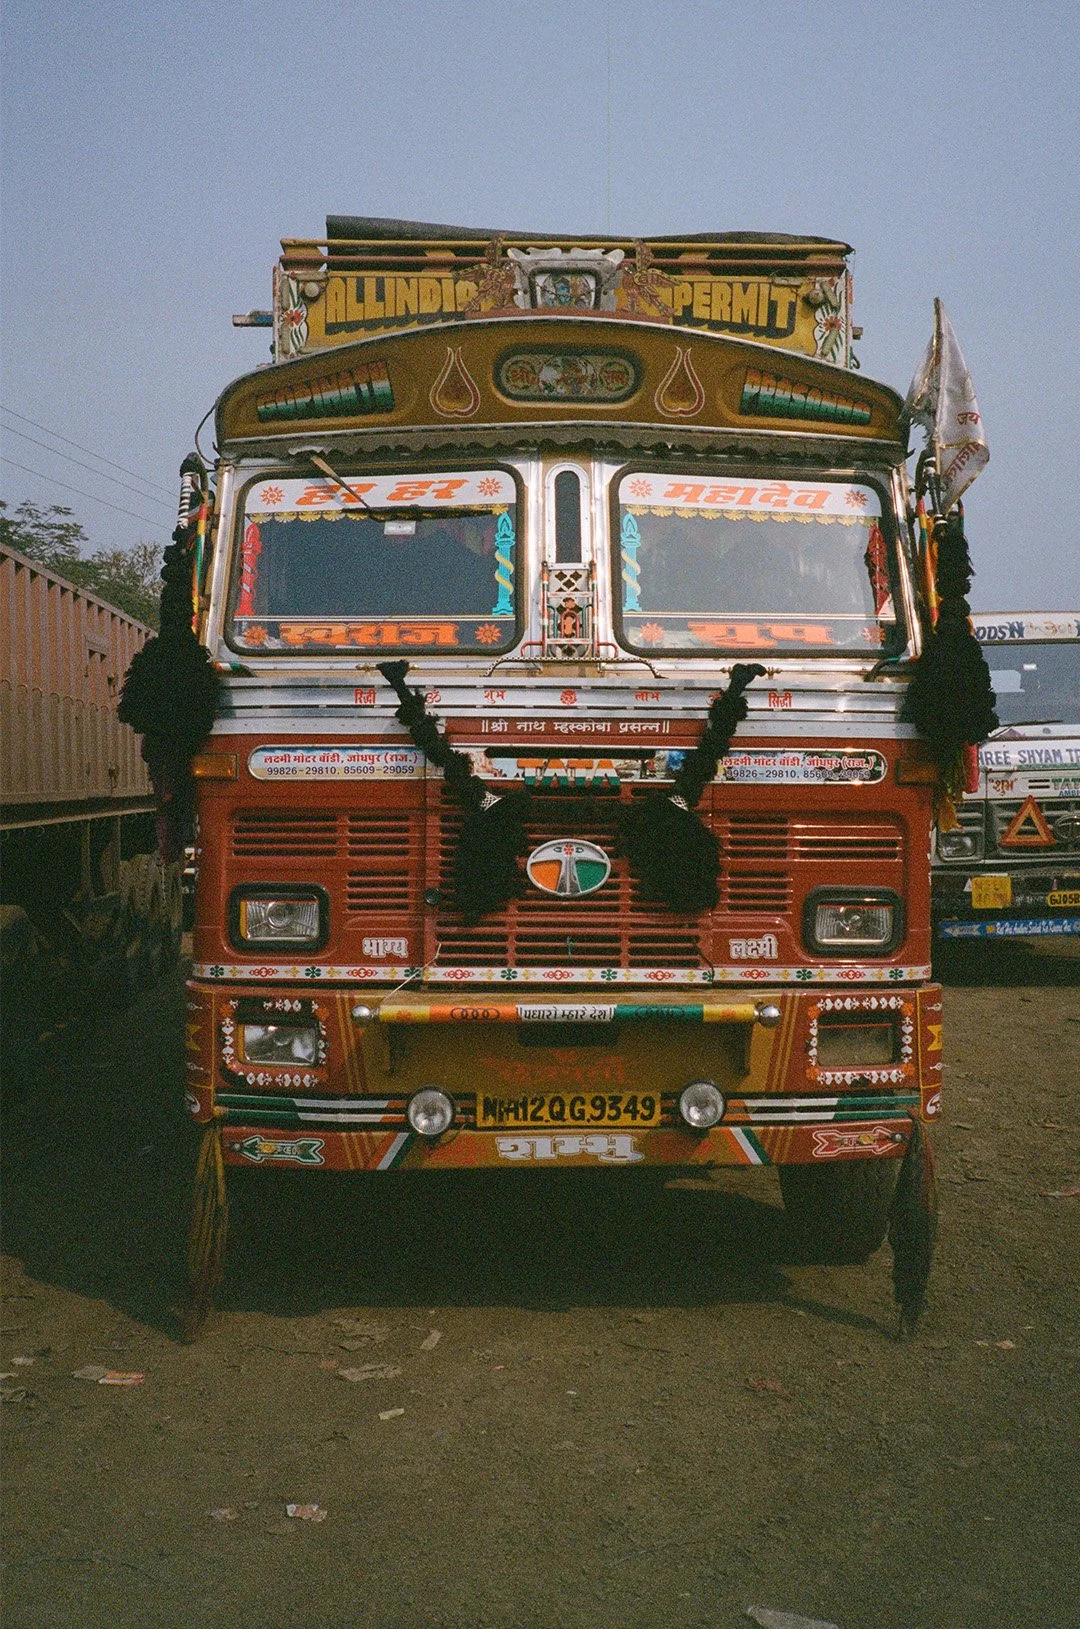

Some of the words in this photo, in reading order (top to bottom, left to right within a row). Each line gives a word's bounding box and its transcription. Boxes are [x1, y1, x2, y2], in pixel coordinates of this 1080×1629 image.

[673, 280, 797, 332] PERMIT
[385, 478, 470, 502] हर
[663, 482, 830, 509] महादेव
[517, 722, 546, 732] नाथ
[1018, 749, 1063, 764] SHYAM
[343, 765, 414, 775] 85609-29059
[516, 759, 619, 786] TATA
